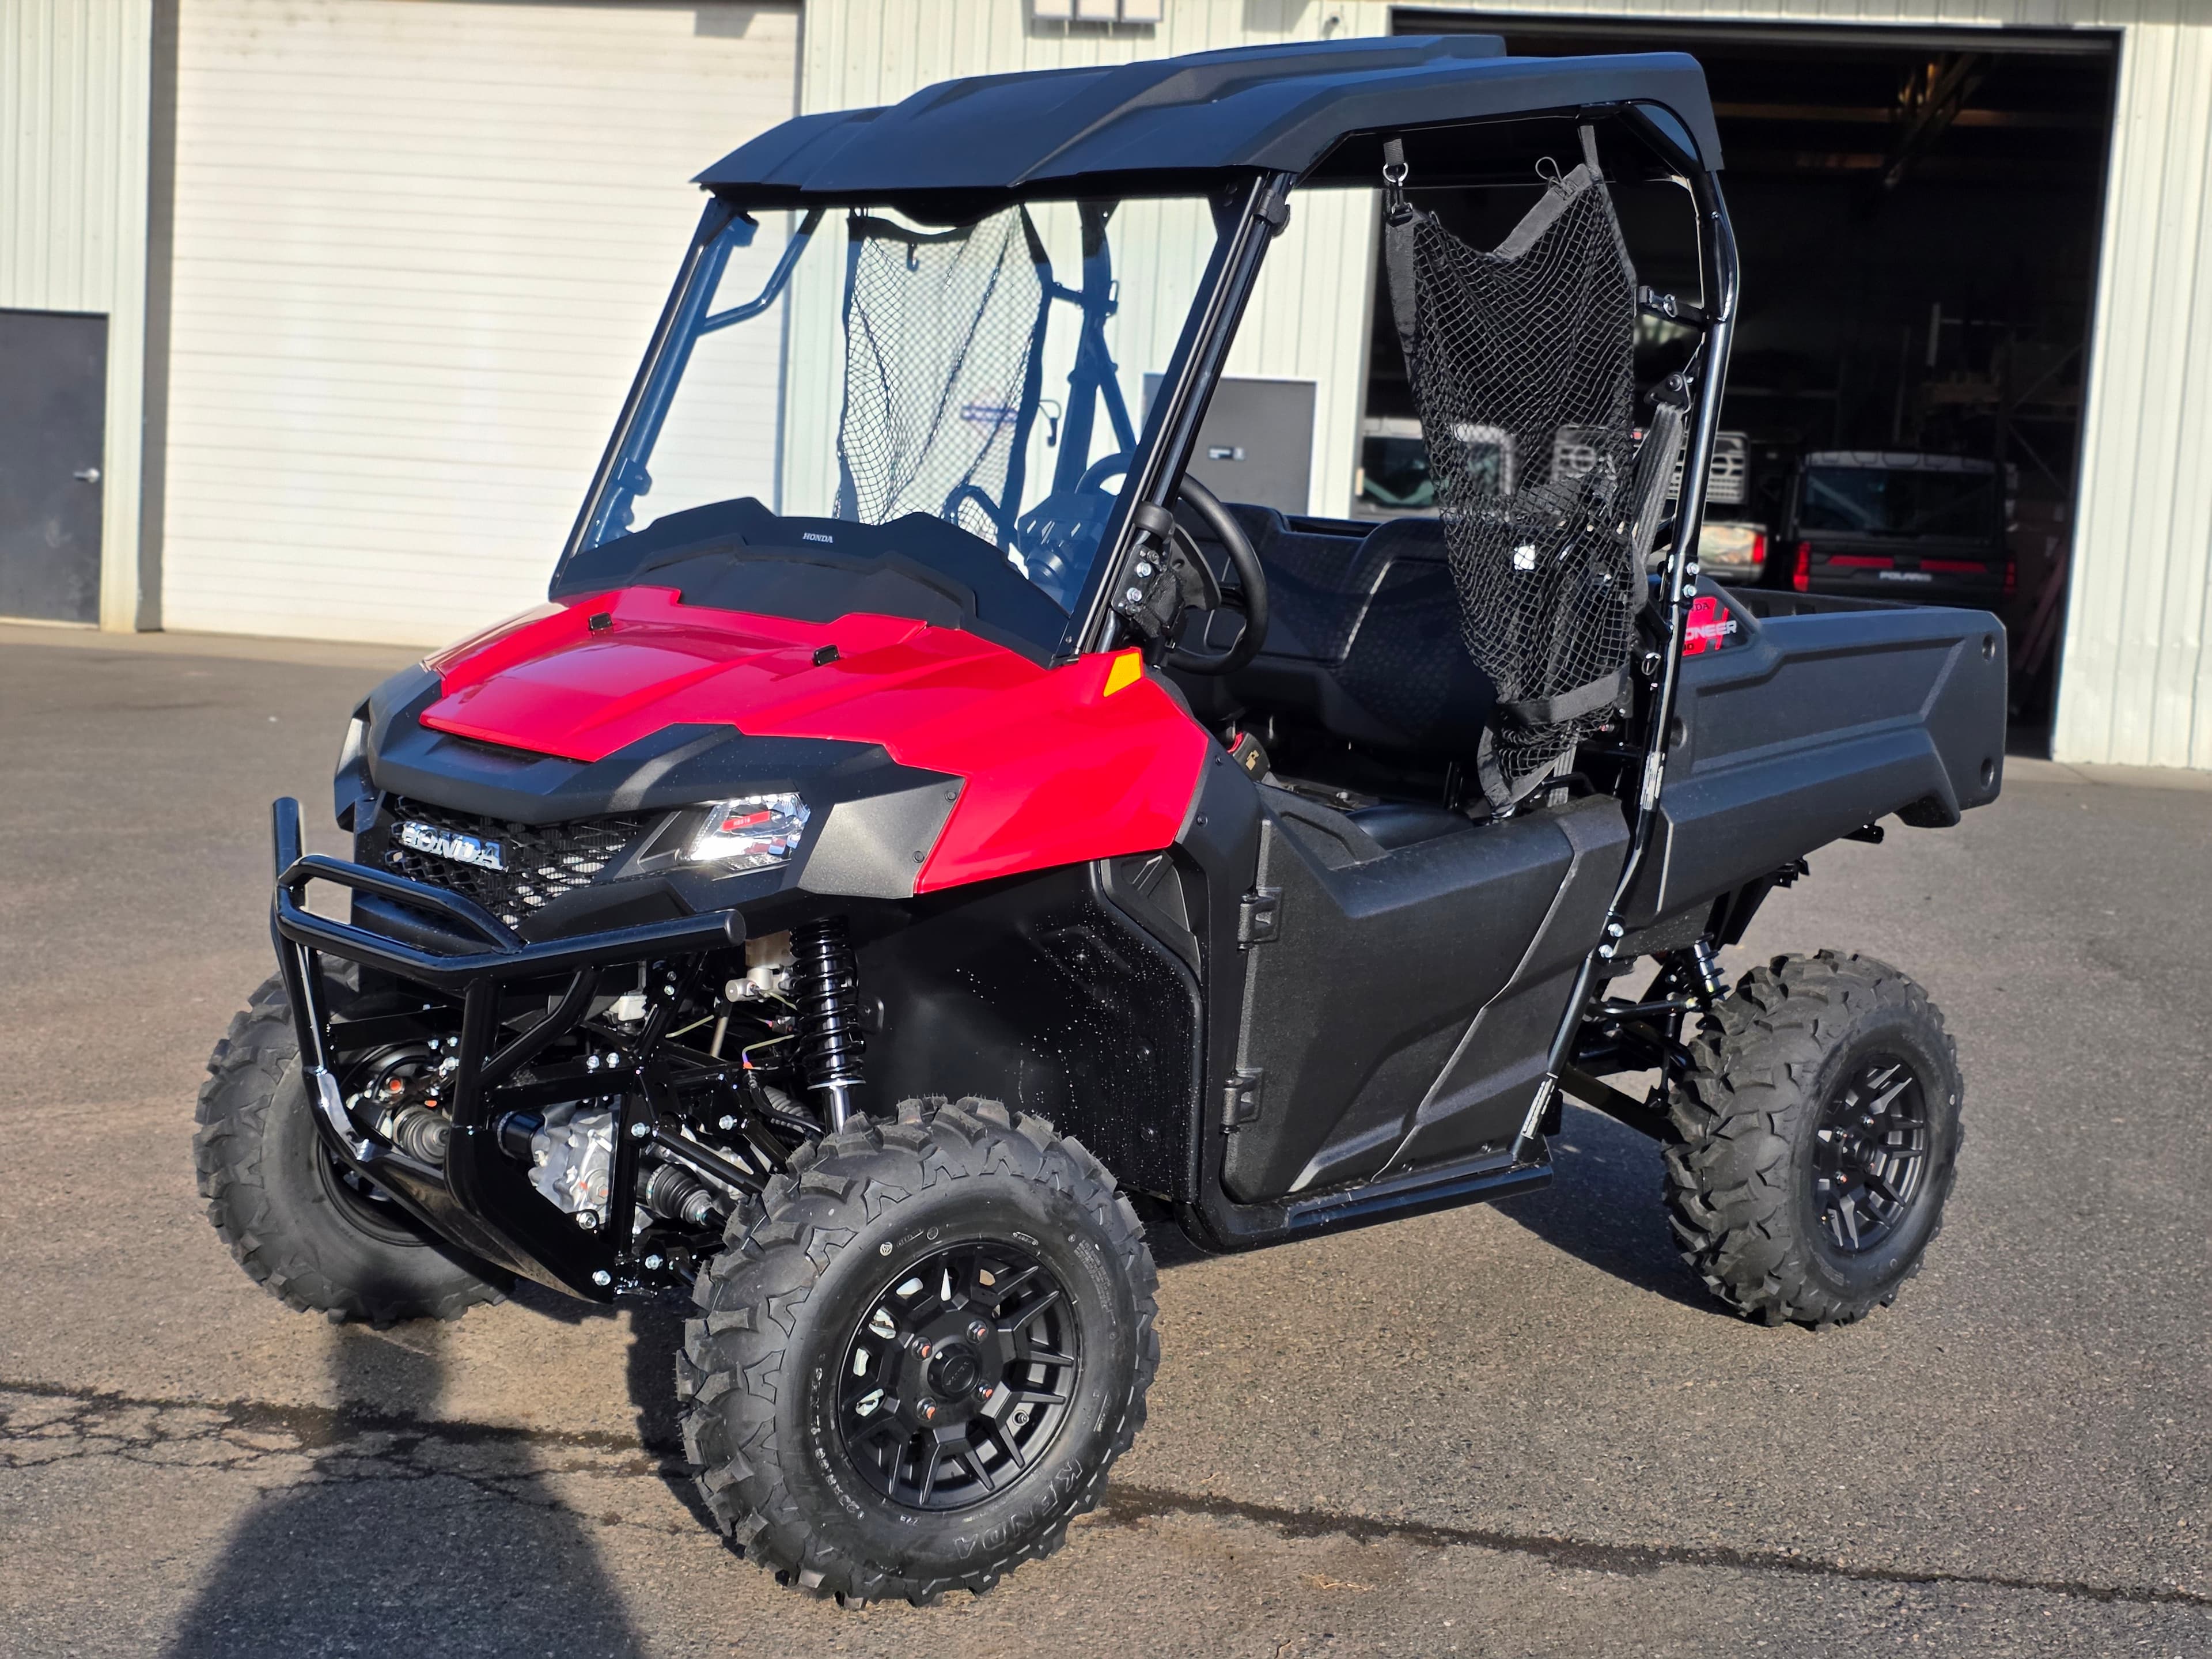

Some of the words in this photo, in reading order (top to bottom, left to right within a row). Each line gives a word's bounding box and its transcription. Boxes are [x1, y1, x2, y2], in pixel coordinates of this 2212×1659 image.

[802, 532, 834, 543] HONDA
[1685, 620, 1737, 641] ONEER
[402, 820, 503, 871] HONDA
[953, 1456, 1083, 1560] KENDA
